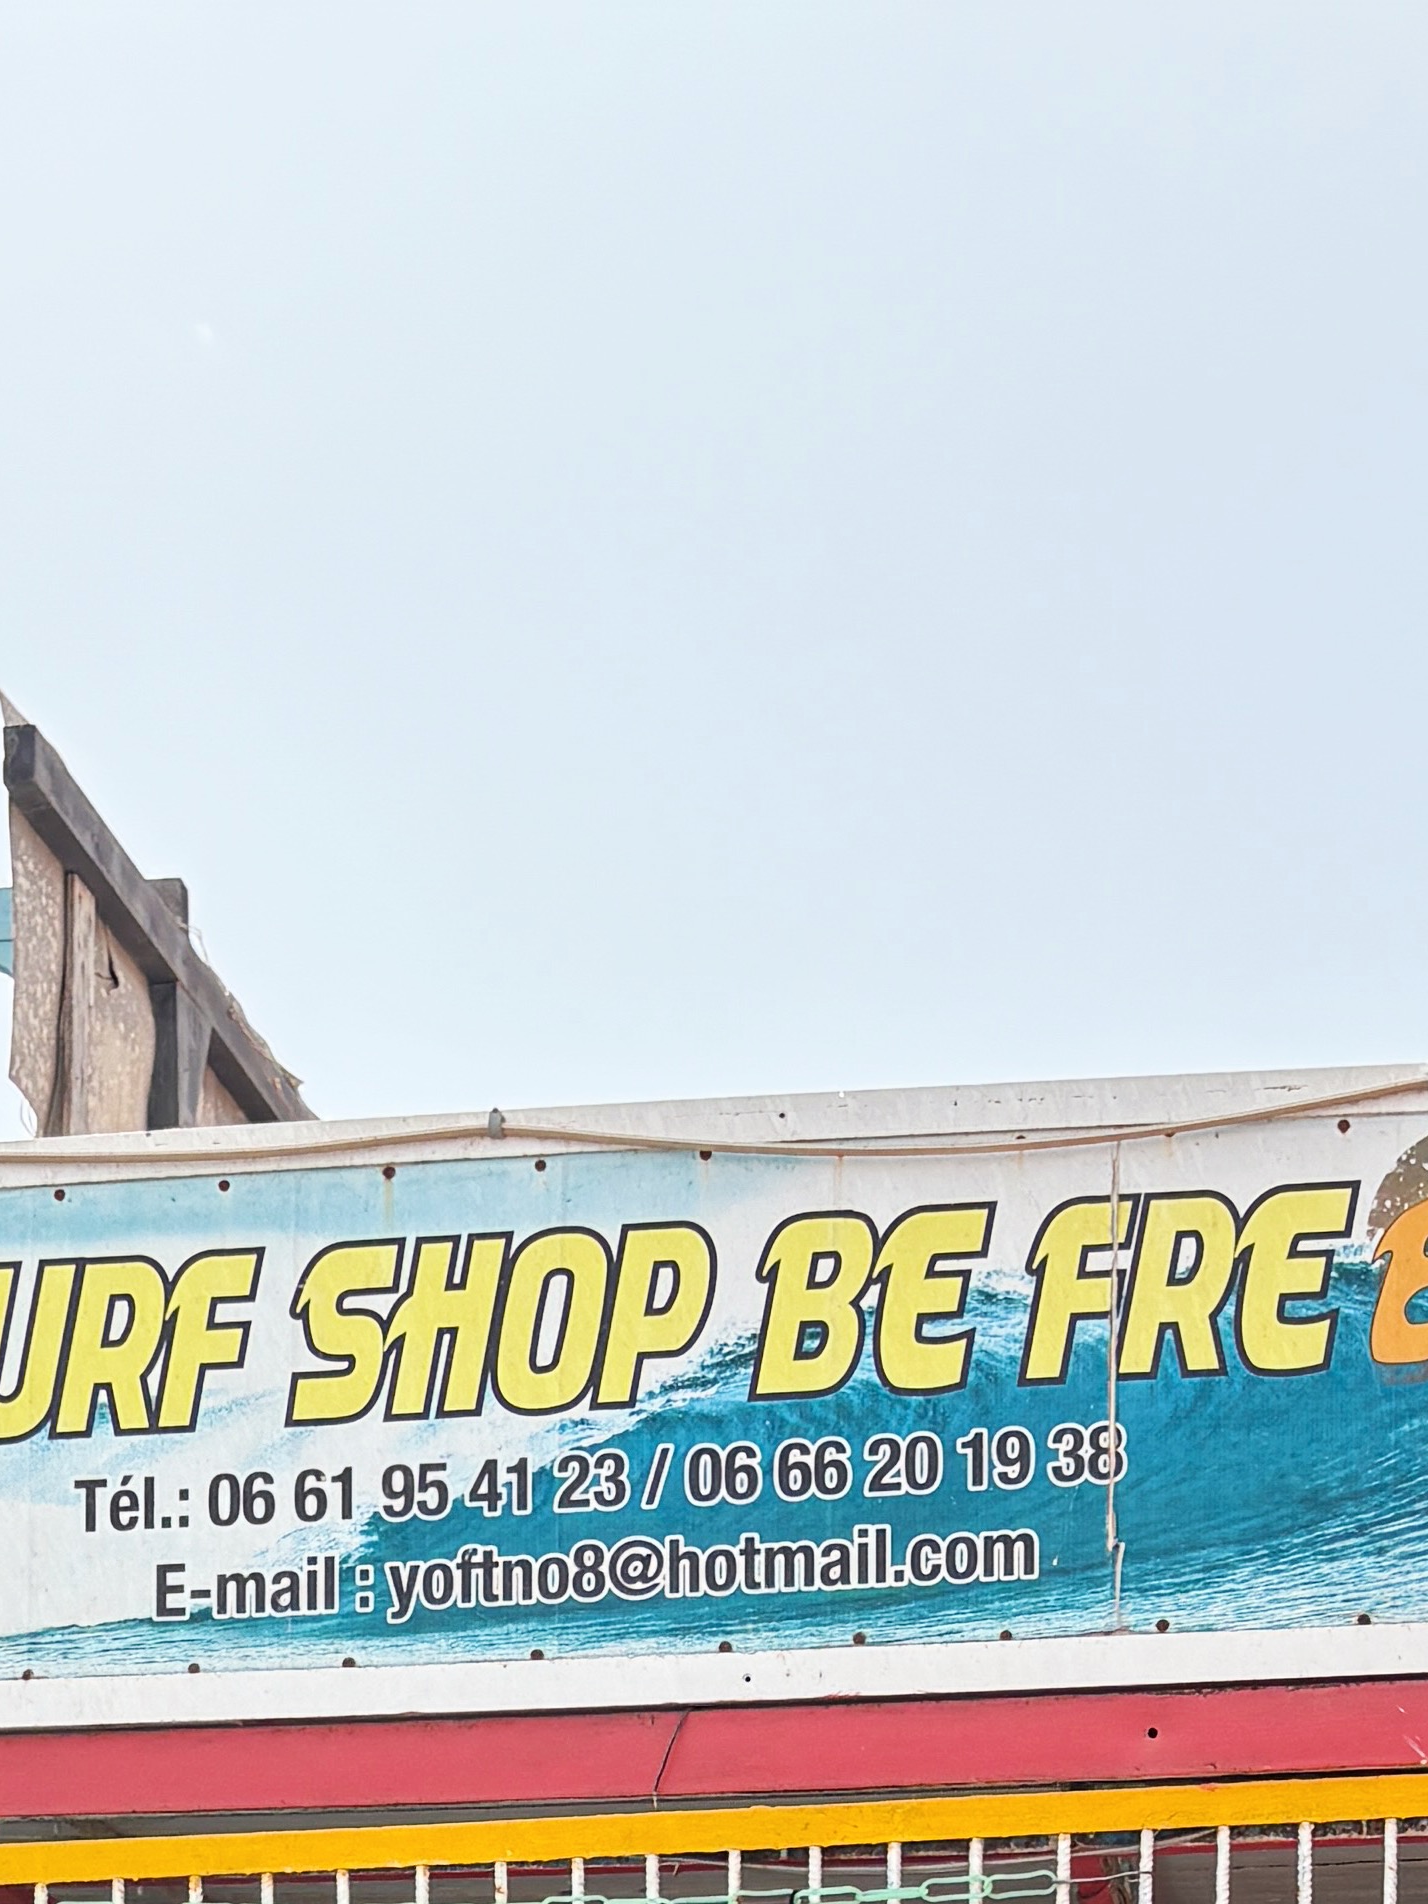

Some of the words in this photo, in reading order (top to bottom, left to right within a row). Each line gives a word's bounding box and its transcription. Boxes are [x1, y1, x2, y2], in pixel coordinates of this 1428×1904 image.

[284, 1220, 718, 1428] SHOP
[748, 1201, 997, 1402] BE
[74, 1475, 189, 1533] Tél.:
[208, 1470, 275, 1526] 06
[293, 1466, 354, 1522] 61
[382, 1463, 449, 1519] 95
[469, 1457, 531, 1513] 41
[557, 1452, 628, 1512] 23
[645, 1446, 670, 1507] /
[689, 1445, 759, 1502] 06
[779, 1440, 849, 1498] 66
[868, 1435, 940, 1492] 20
[960, 1429, 1031, 1488] 19
[1052, 1424, 1124, 1483] 38
[154, 1555, 337, 1619] E-mail
[390, 1527, 1035, 1620] yoftno8@hotmail.com
